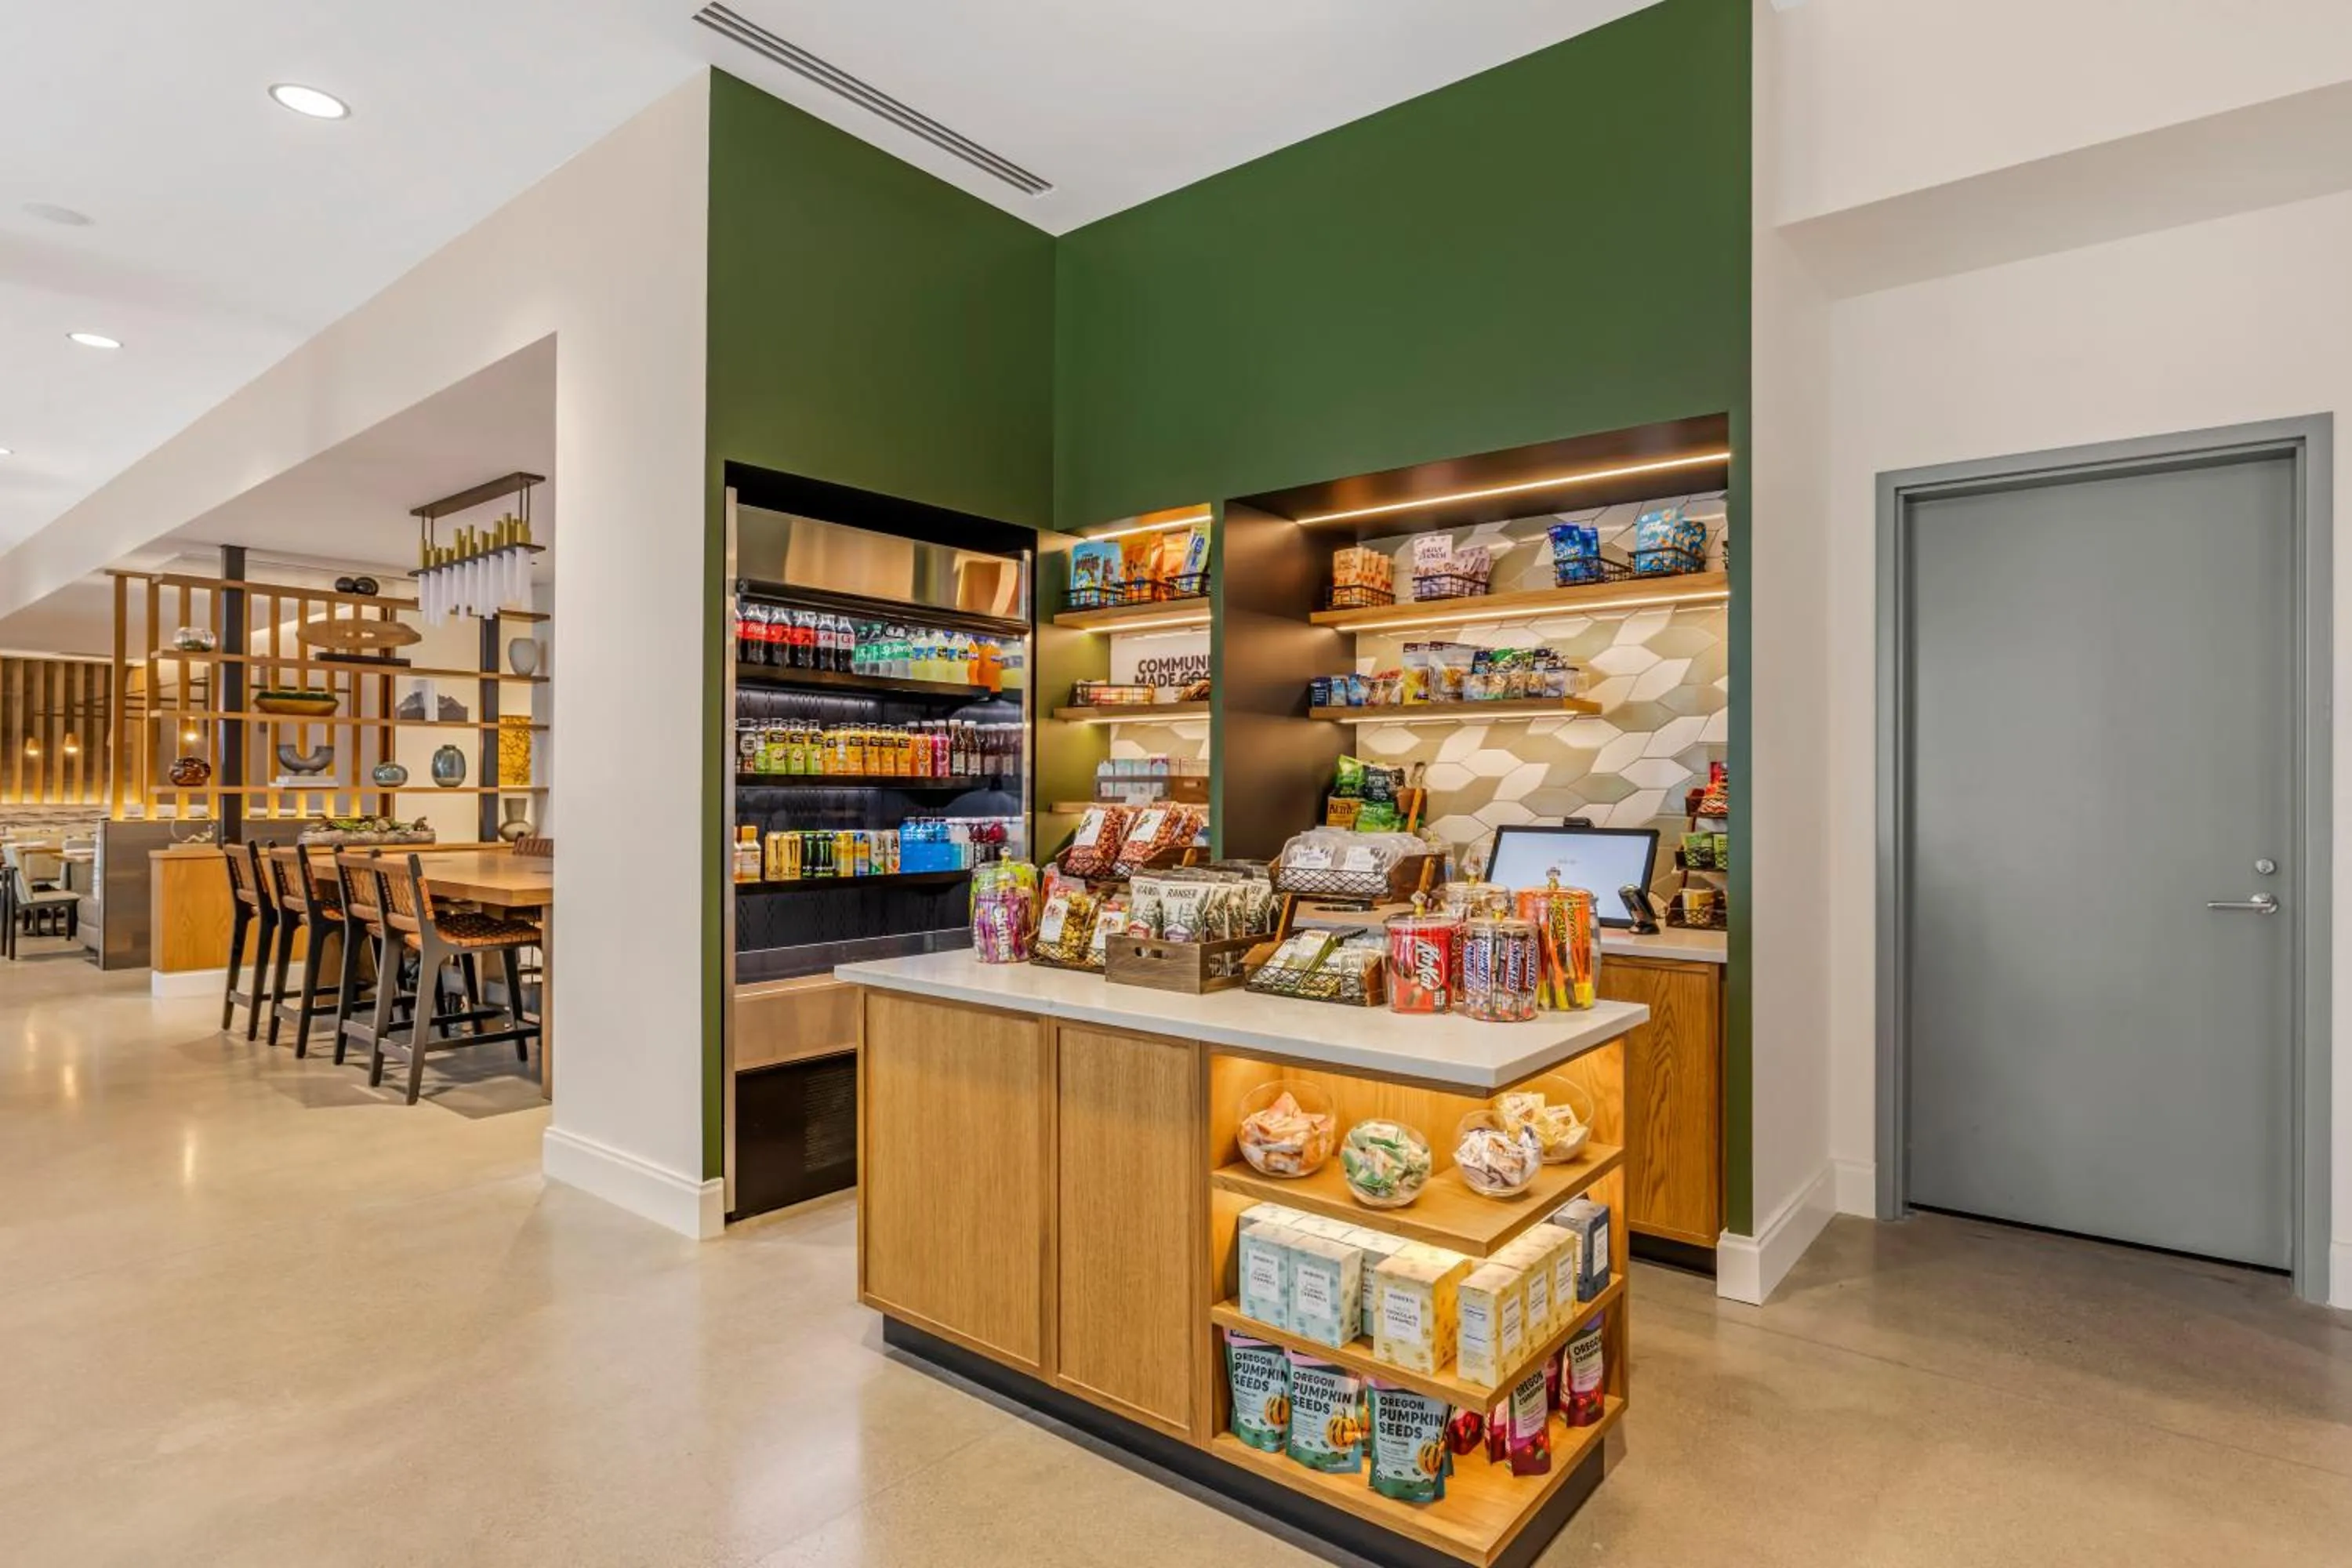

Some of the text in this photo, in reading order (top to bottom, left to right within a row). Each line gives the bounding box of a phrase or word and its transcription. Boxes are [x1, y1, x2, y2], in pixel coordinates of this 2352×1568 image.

[1134, 672, 1174, 688] MADE
[1236, 1352, 1272, 1367] OREGON
[1235, 1363, 1288, 1384] PUMPKIN
[1294, 1371, 1336, 1388] OREGON
[1234, 1374, 1269, 1392] SEEDS
[1293, 1381, 1353, 1404] PUMPKIN
[1291, 1394, 1330, 1415] SEEDS
[1380, 1396, 1425, 1410] OREGON
[1379, 1407, 1444, 1428] PUMPKIN
[1379, 1421, 1424, 1439] SEEDS
